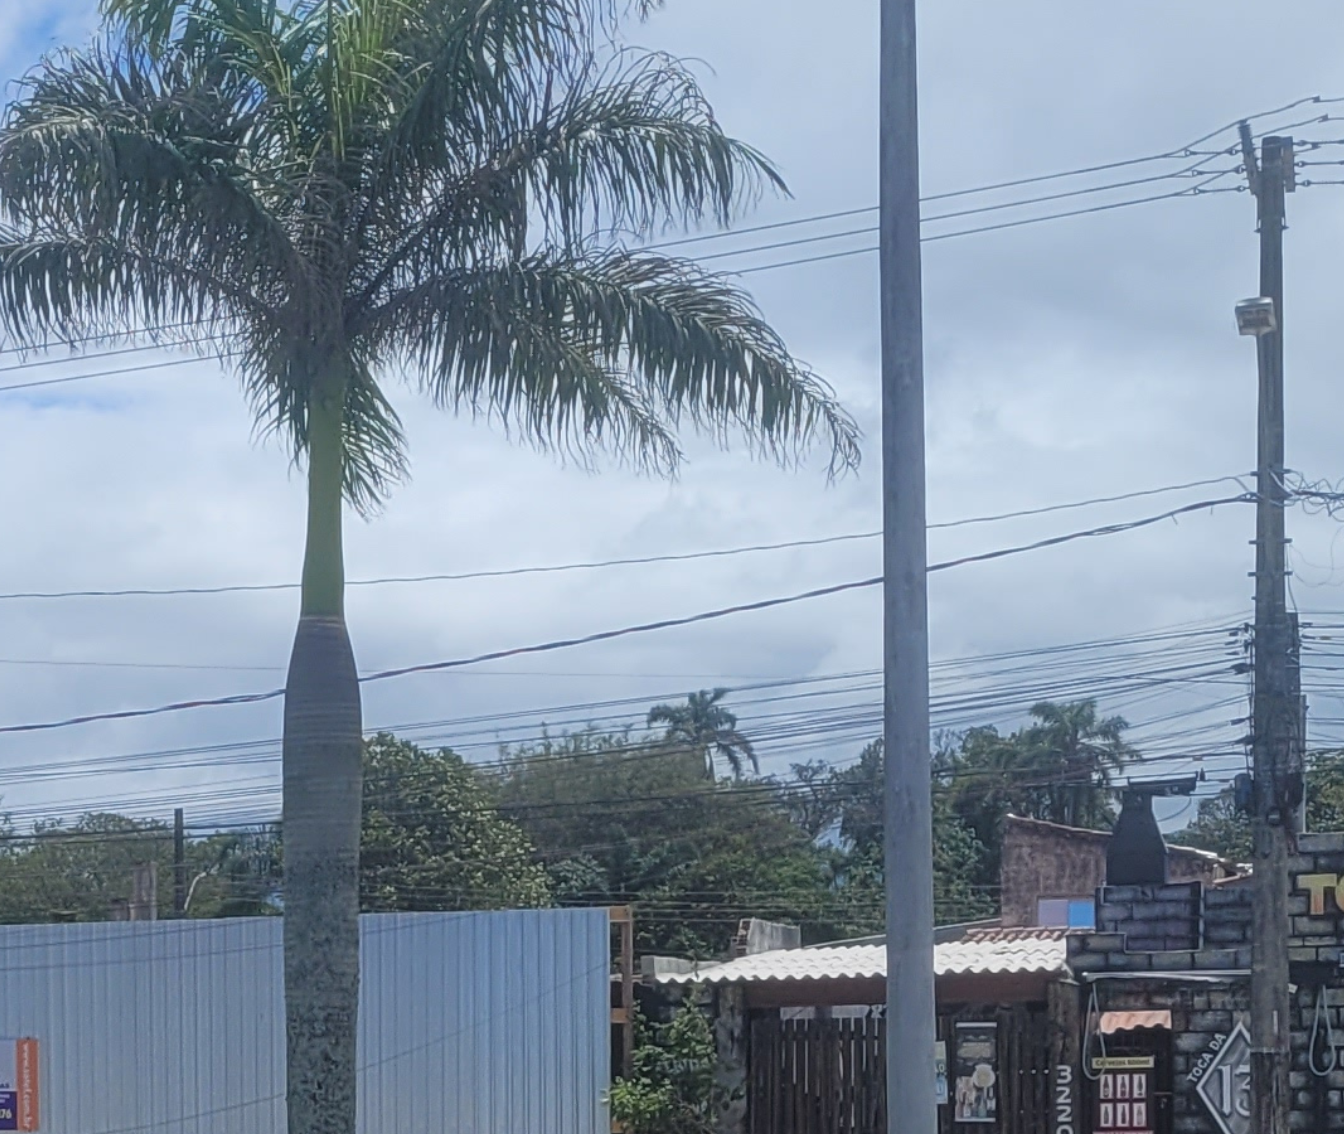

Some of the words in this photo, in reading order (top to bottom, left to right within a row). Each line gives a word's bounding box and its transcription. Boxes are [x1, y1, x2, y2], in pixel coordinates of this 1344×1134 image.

[1296, 872, 1344, 915] T
[1187, 1052, 1214, 1083] TOCA
[1209, 1033, 1227, 1051] DA
